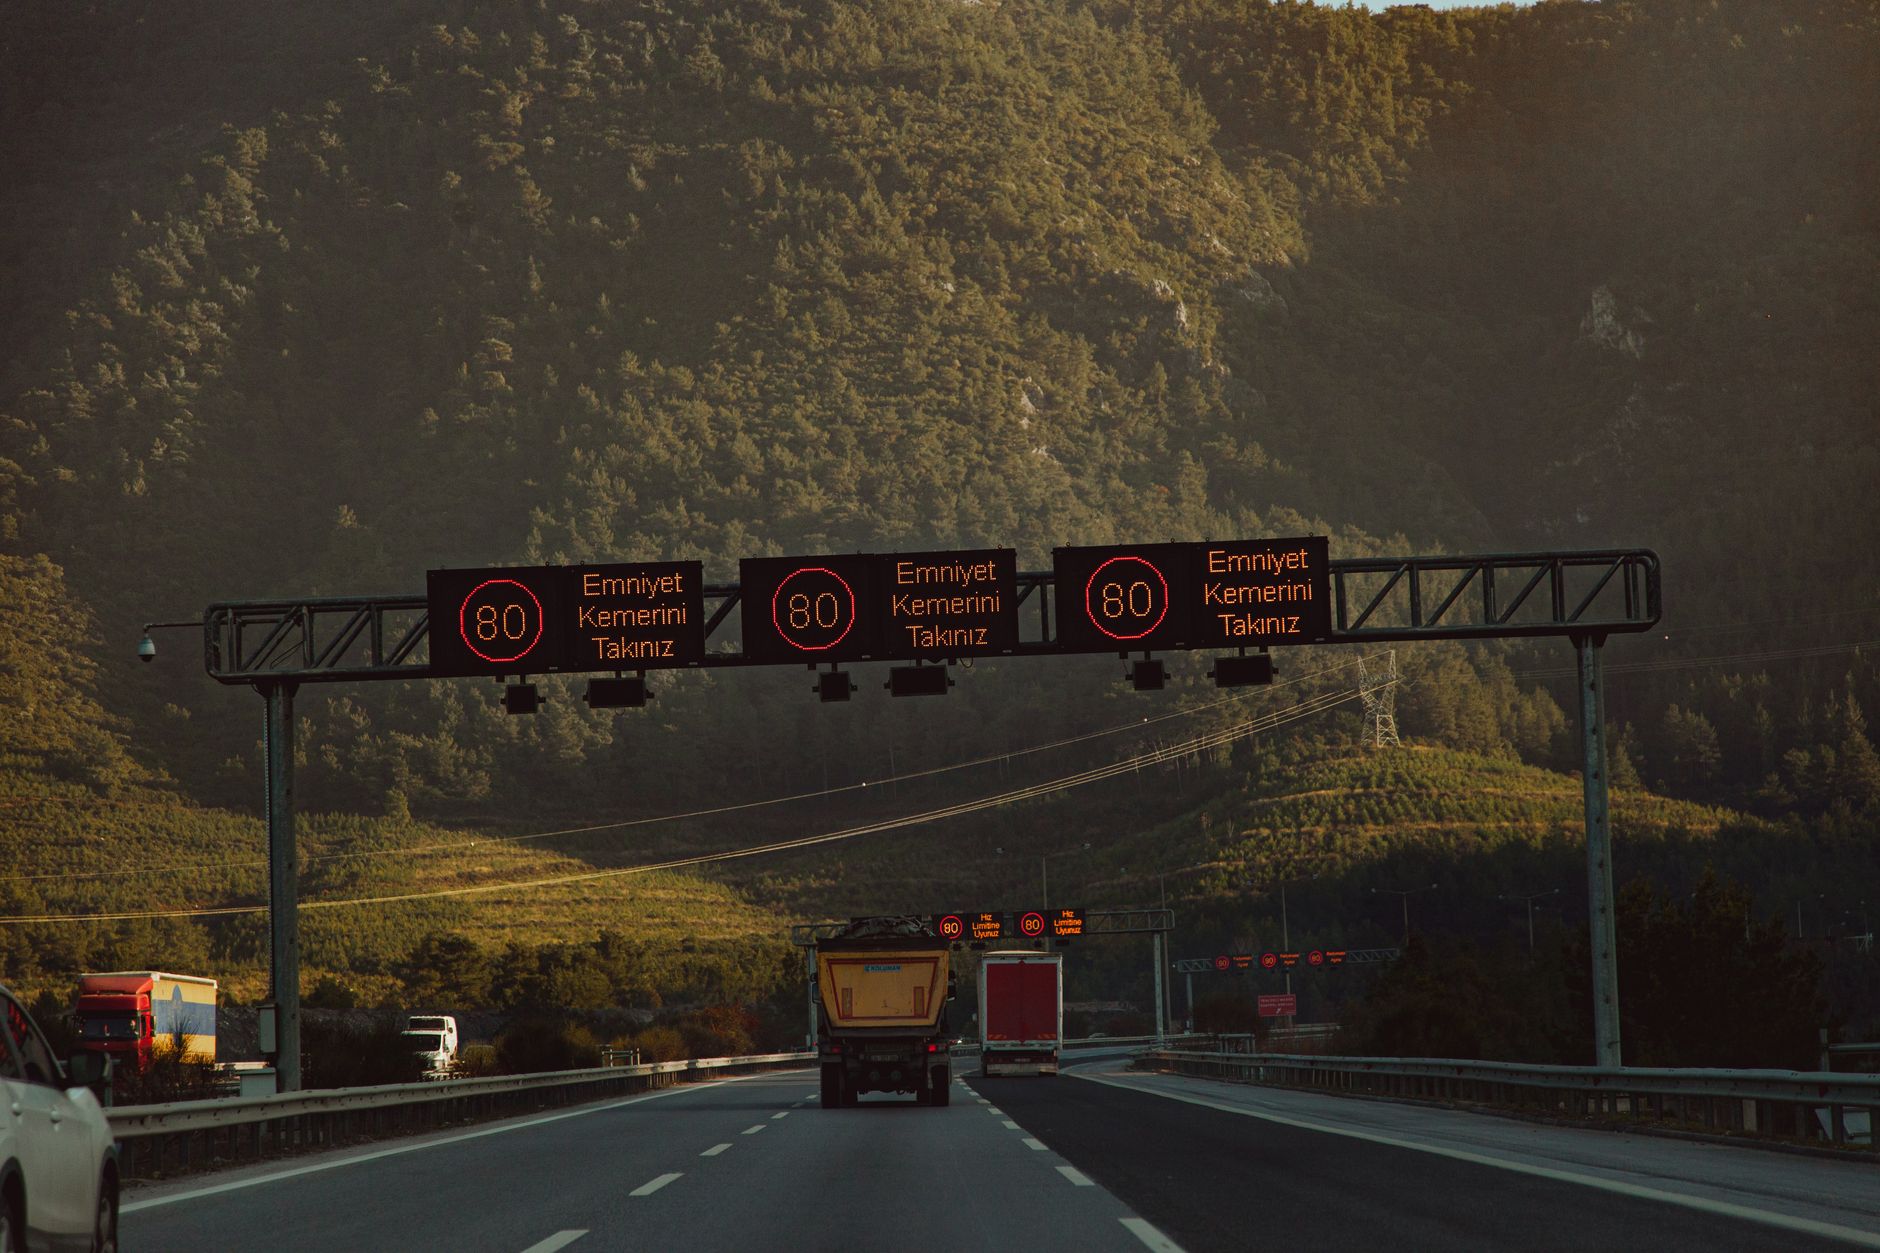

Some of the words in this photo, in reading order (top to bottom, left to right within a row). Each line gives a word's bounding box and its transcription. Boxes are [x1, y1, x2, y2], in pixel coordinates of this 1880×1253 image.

[1209, 548, 1309, 575] Emniyet
[583, 572, 683, 598] Emniyet
[897, 560, 997, 587] Emniyet
[1103, 582, 1152, 618] 80
[1205, 579, 1312, 605] Kemerini
[579, 604, 686, 627] Kemerini
[789, 593, 838, 628] 80
[893, 592, 1000, 616] Kemerini
[477, 604, 526, 640] 80
[1217, 613, 1300, 636] Takınız
[905, 624, 988, 647] Takınız
[592, 637, 675, 659] Takınız
[943, 922, 958, 933] 80
[972, 922, 1000, 930] Limitine
[1024, 919, 1040, 930] 80
[1054, 918, 1082, 927] Limitine
